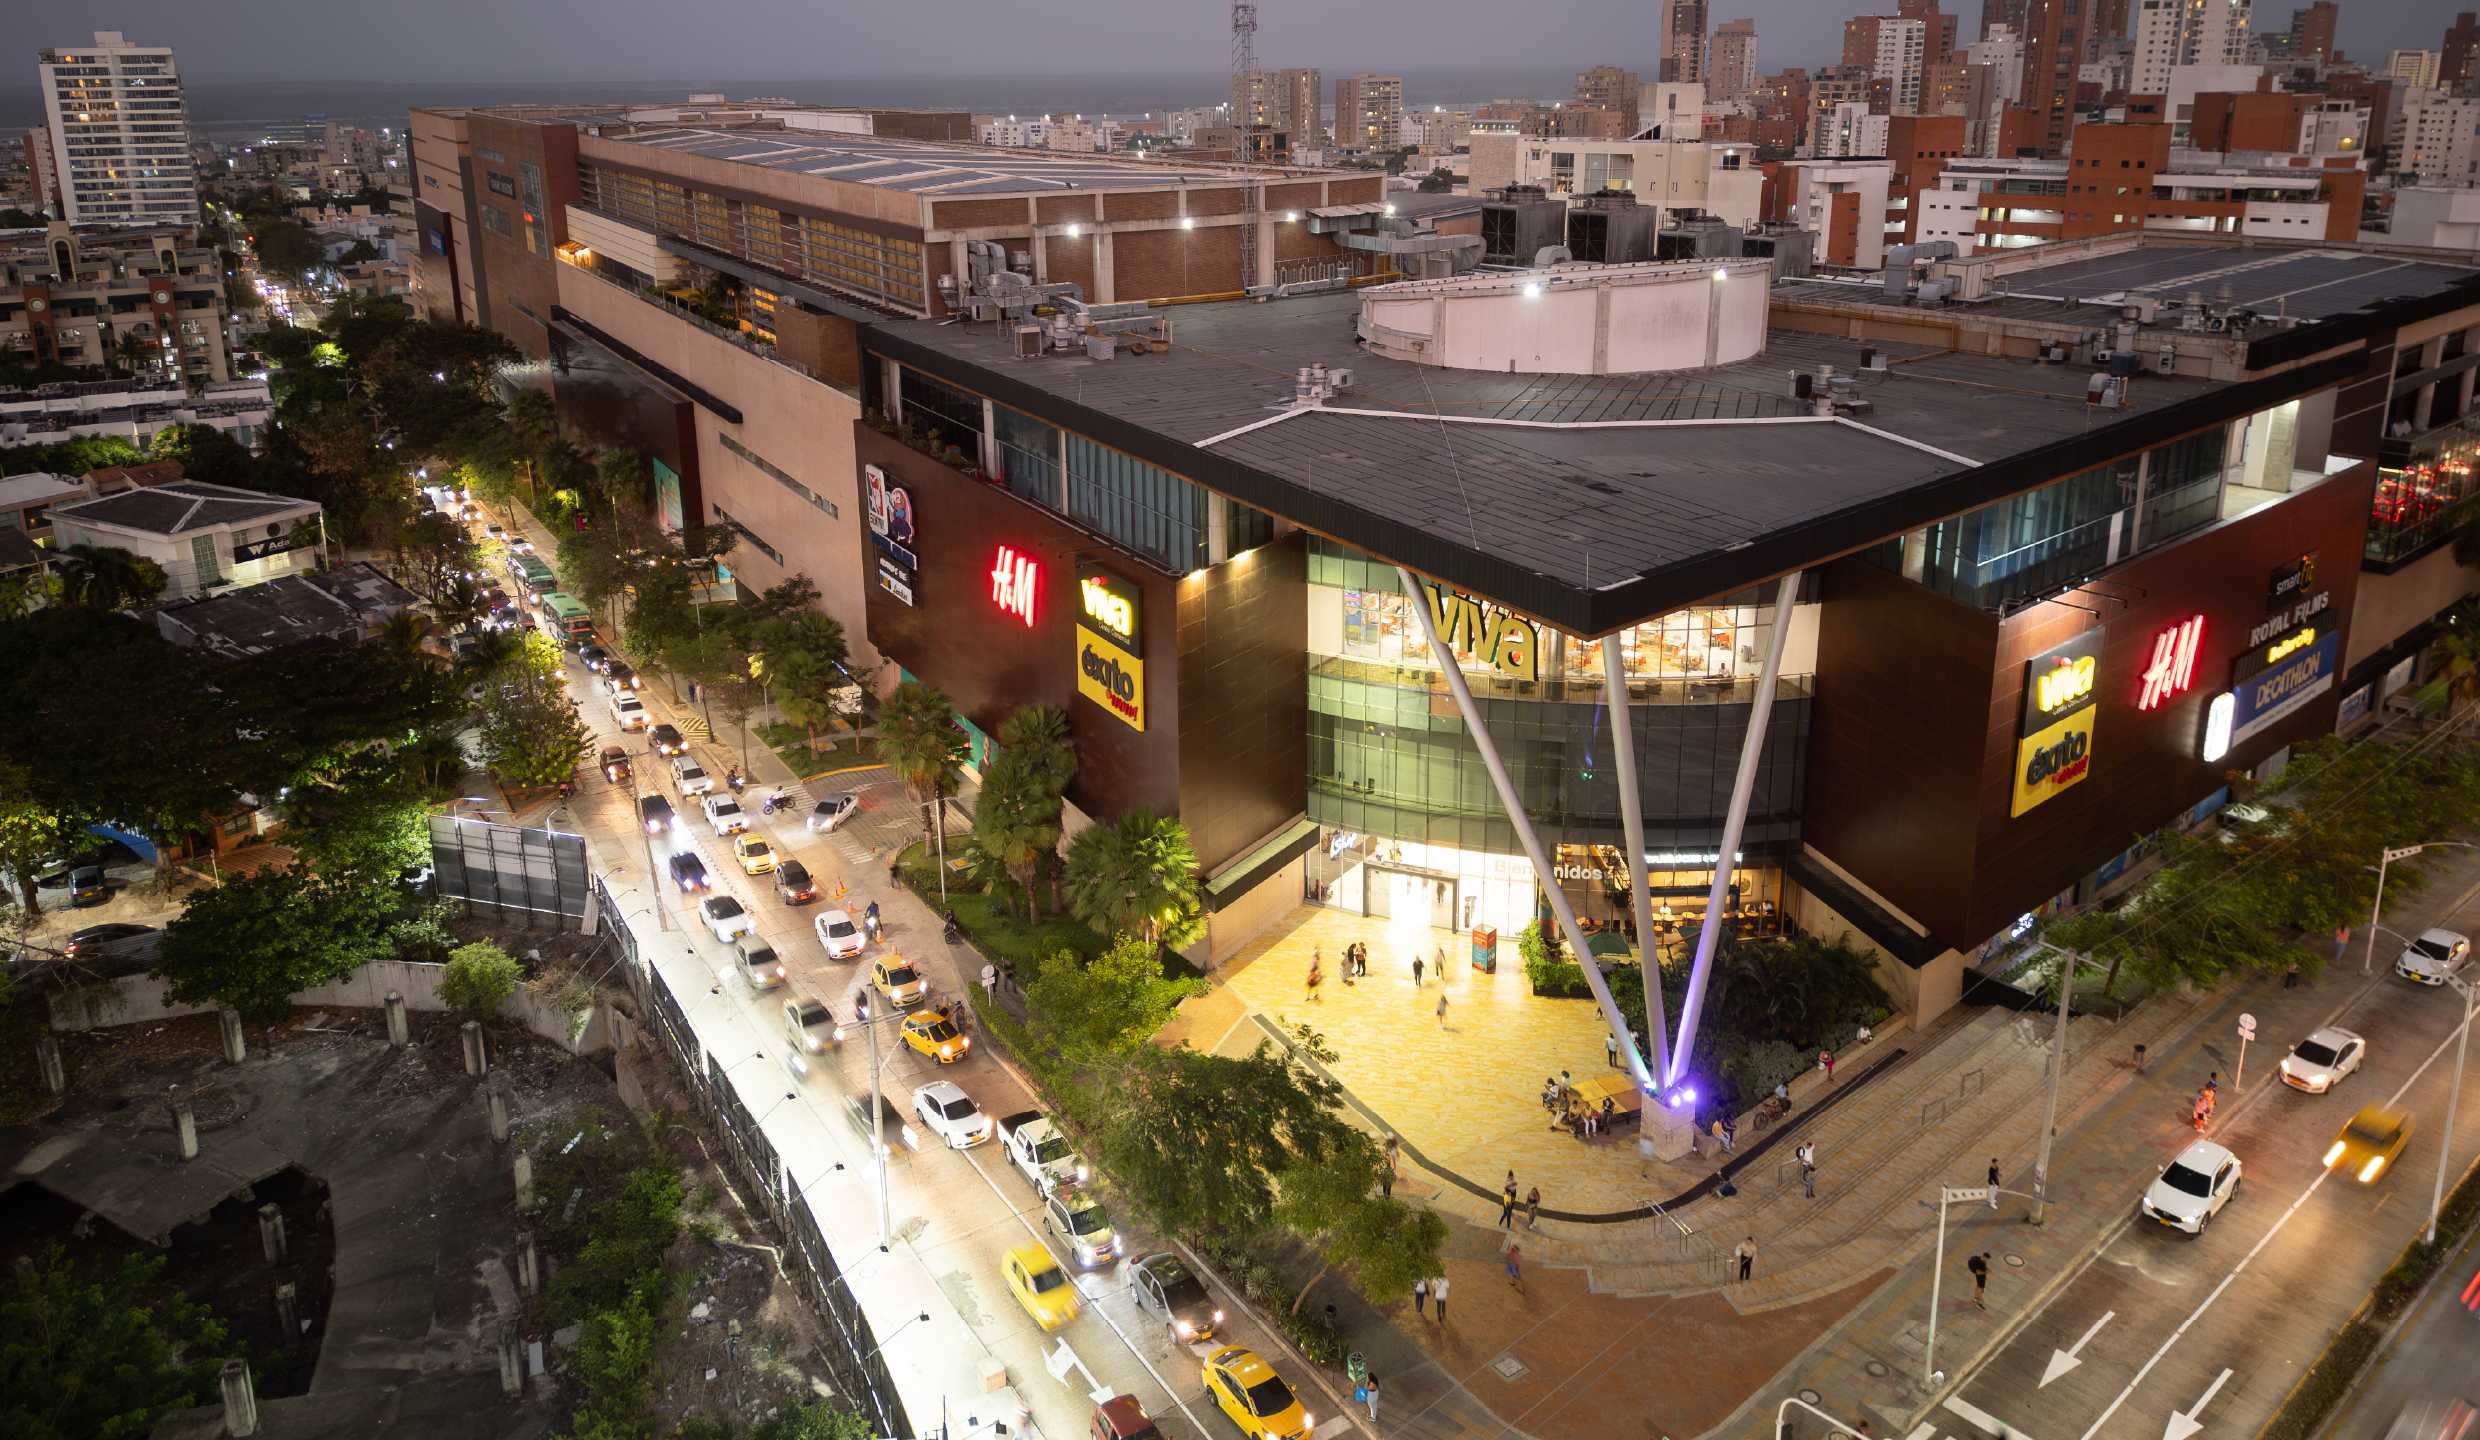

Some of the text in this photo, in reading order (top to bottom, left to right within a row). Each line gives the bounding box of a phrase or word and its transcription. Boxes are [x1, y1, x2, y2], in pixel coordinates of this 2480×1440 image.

[991, 545, 1038, 628] H&M
[1080, 576, 1132, 637] viva
[2276, 571, 2302, 595] smart
[1426, 584, 1539, 682] viva
[2249, 591, 2329, 648] ROYAL FILMS
[2267, 628, 2316, 664] Dollarcity
[1081, 643, 1134, 702] éxito
[2037, 655, 2096, 713] viva
[2139, 614, 2204, 711] H&M
[2254, 651, 2321, 710] DECATHLON
[2026, 730, 2088, 786] éxito
[1643, 852, 1702, 864] TARBUCKS
